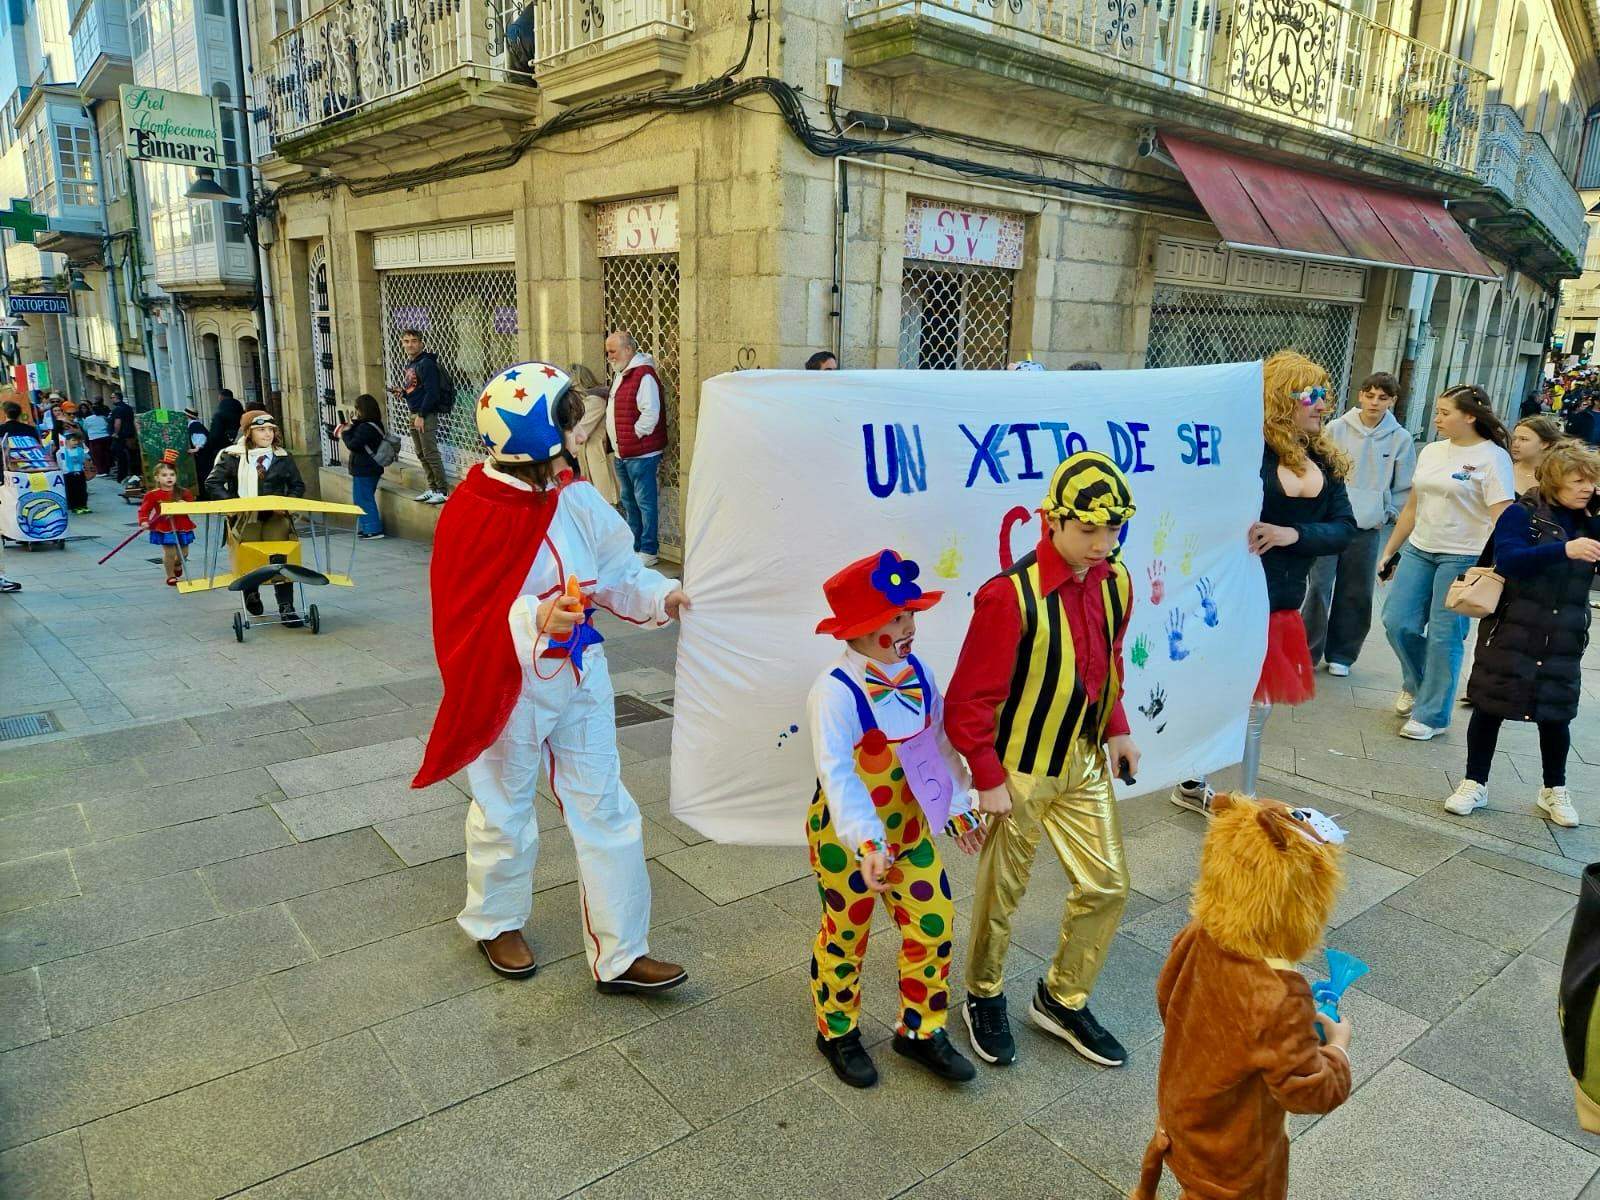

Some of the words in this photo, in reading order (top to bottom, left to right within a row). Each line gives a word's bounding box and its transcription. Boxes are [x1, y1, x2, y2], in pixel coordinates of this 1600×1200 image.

[126, 89, 165, 111] Piel
[133, 110, 217, 140] Confecciones
[129, 127, 216, 163] Tamara
[627, 203, 666, 249] SV
[934, 208, 988, 259] SV
[10, 298, 68, 312] ORTOPEDIA
[862, 422, 927, 498] UN
[1106, 420, 1155, 473] DE
[1177, 421, 1222, 466] SER
[917, 760, 942, 802] 5
